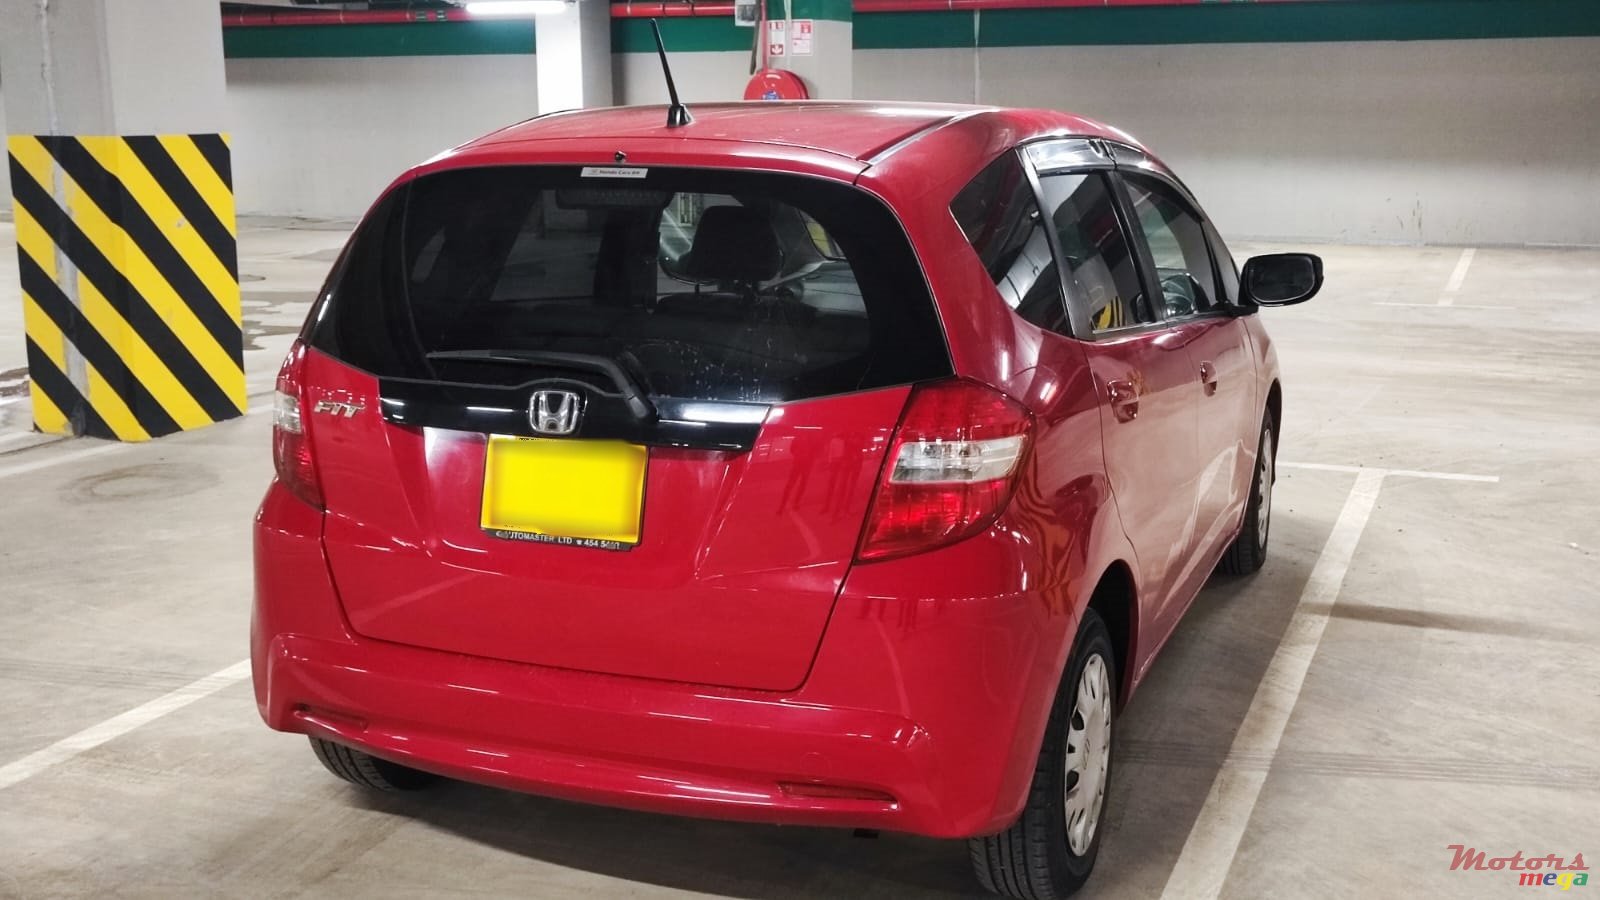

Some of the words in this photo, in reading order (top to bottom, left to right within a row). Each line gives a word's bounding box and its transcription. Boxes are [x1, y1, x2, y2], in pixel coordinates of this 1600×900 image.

[314, 400, 366, 418] FIT
[557, 536, 573, 545] LTD
[583, 538, 598, 548] 454
